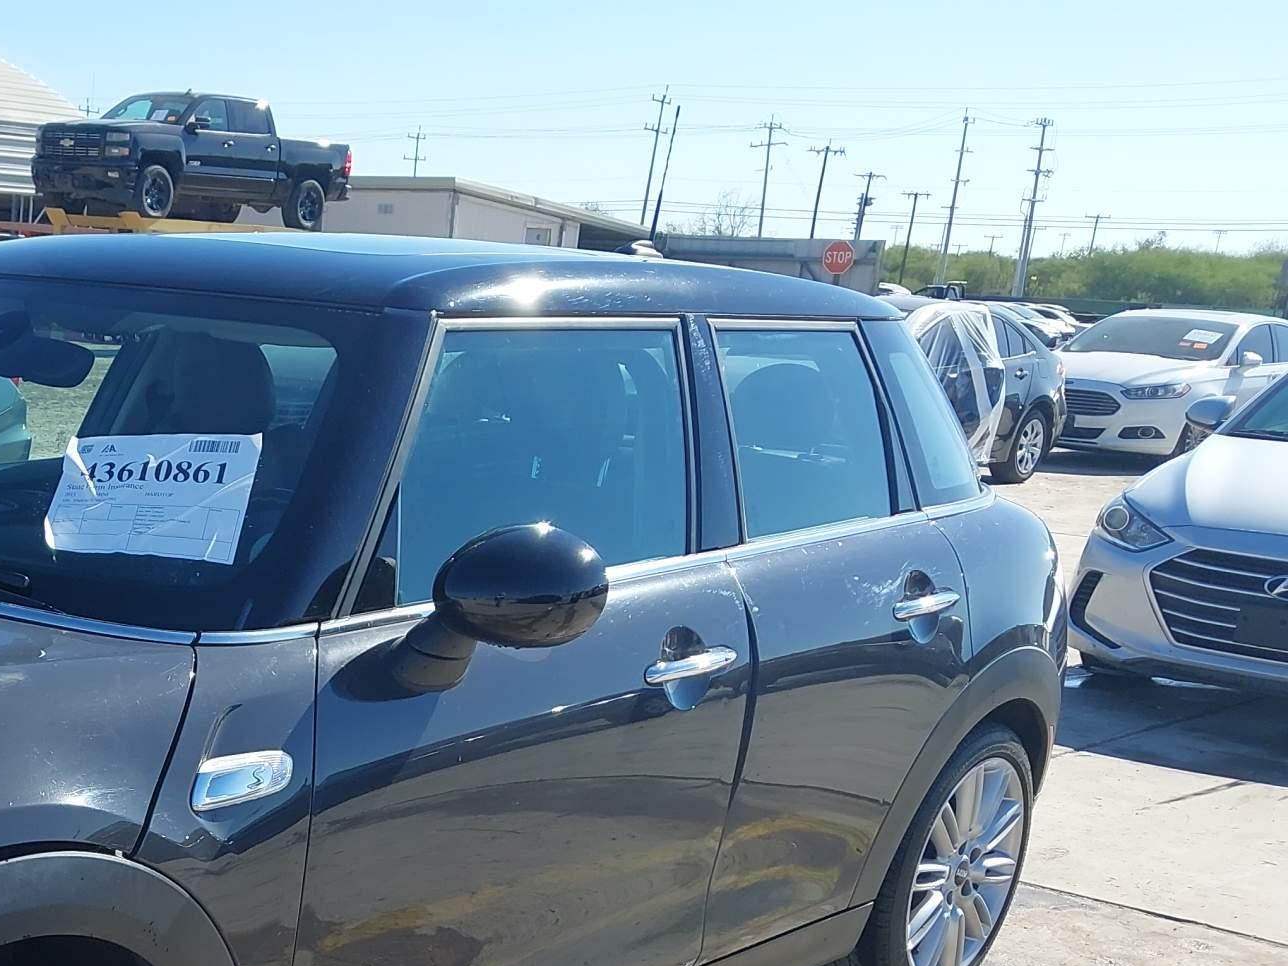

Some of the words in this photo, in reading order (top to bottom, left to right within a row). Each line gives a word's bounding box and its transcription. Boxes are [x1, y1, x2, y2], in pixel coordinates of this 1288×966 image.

[825, 251, 852, 264] STOP
[81, 460, 228, 485] 43610861
[108, 482, 144, 490] Insurance
[246, 766, 266, 789] S
